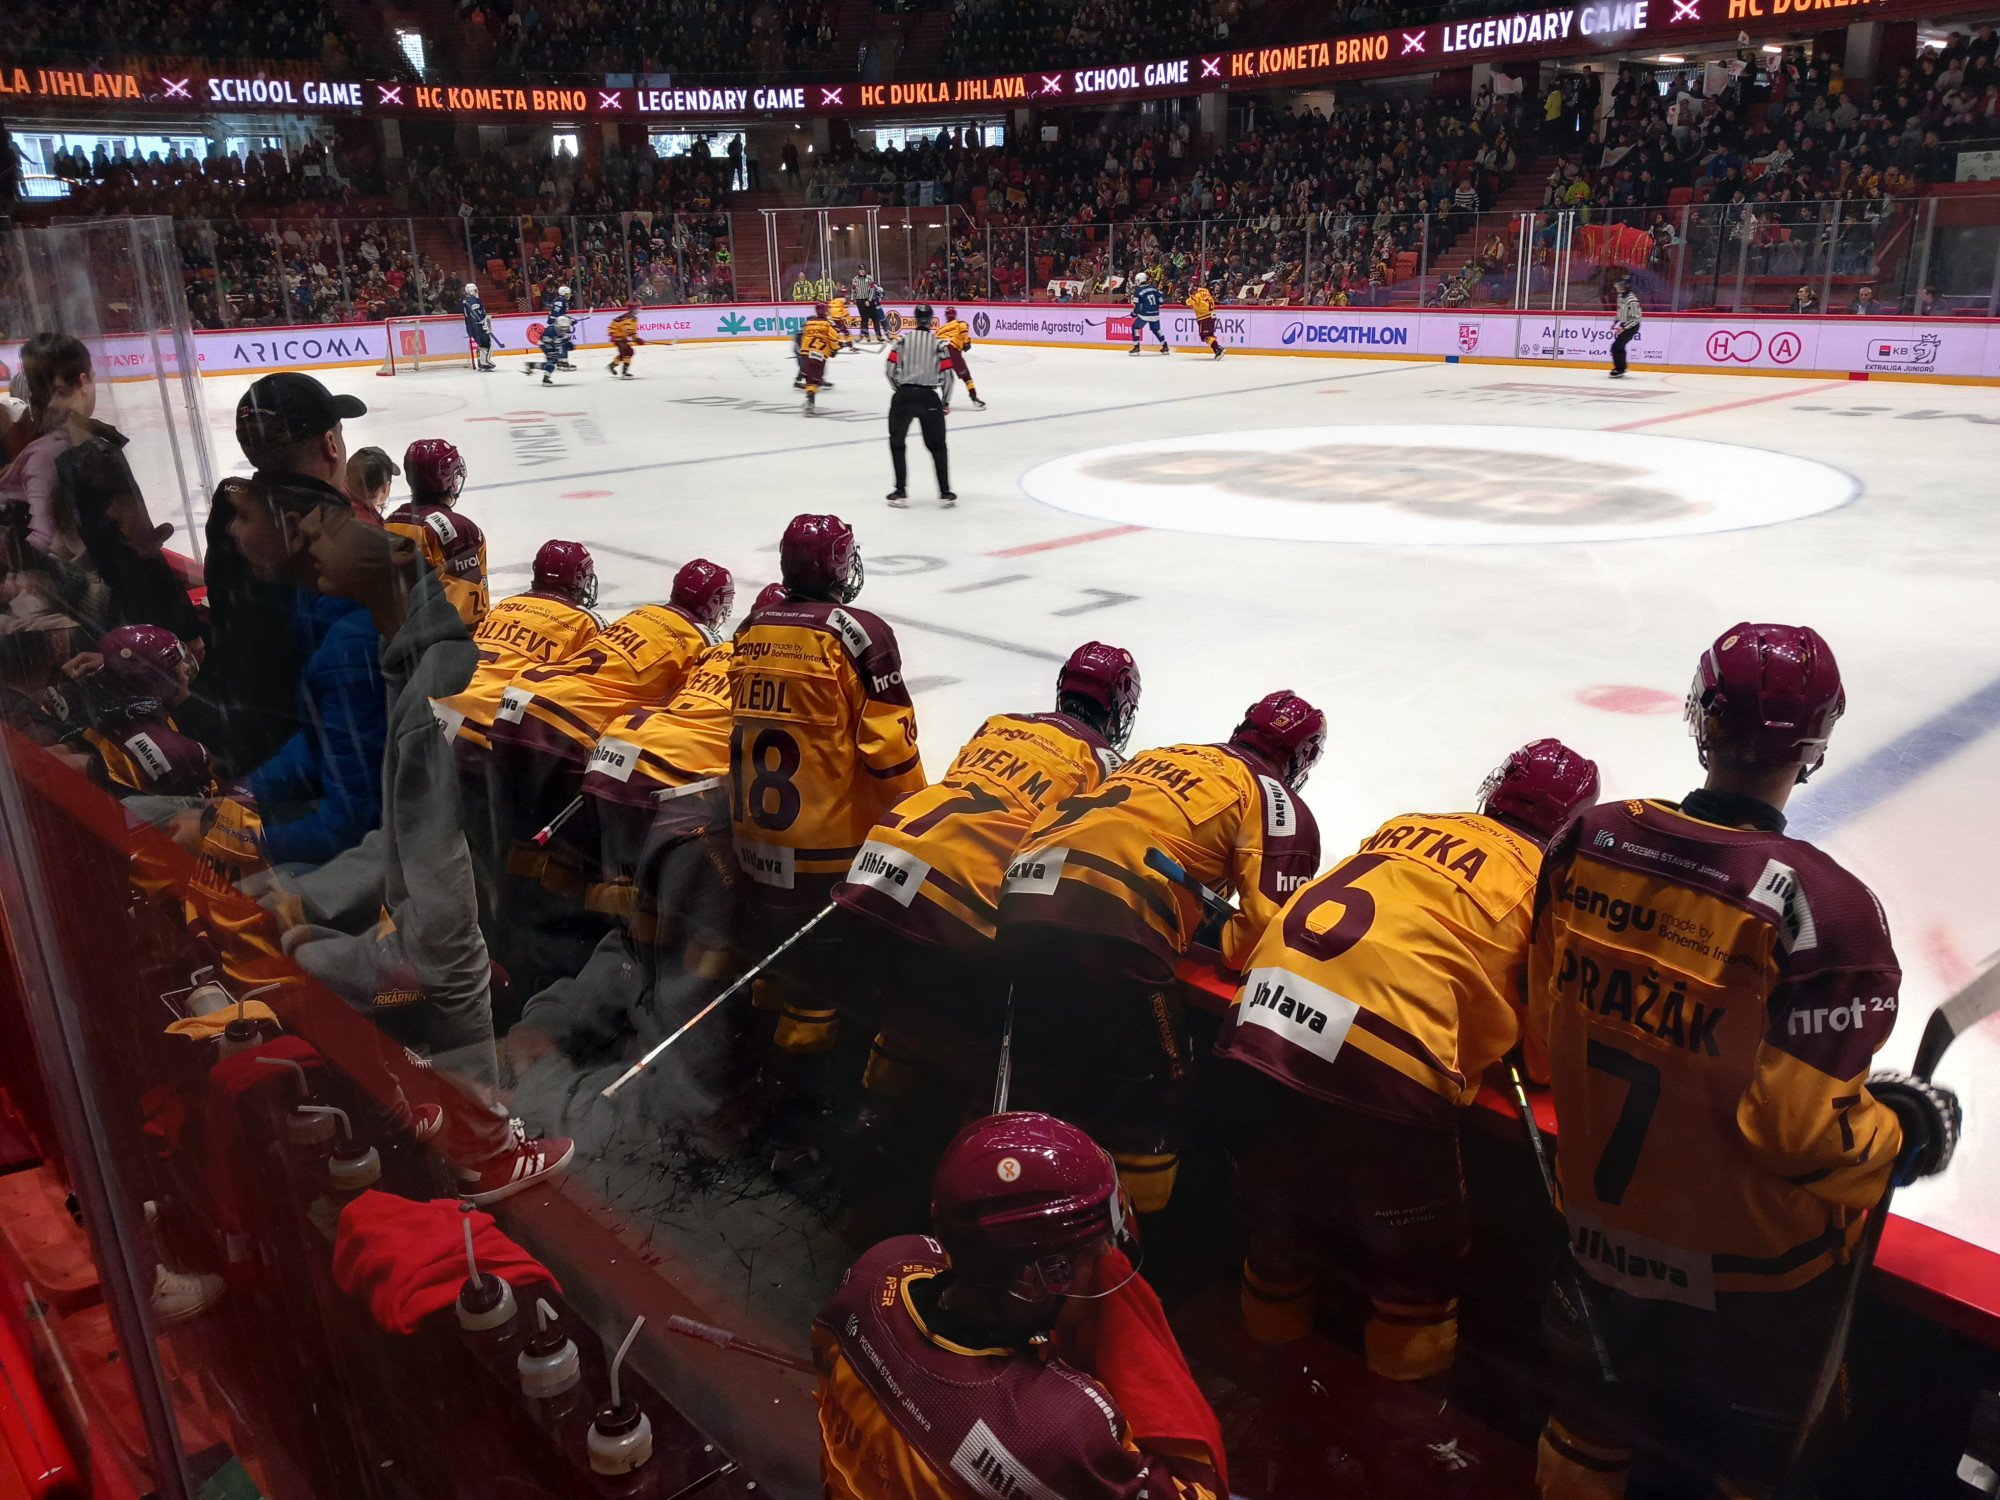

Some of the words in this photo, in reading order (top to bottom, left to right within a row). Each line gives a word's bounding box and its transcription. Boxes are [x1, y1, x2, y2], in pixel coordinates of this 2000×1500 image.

[1443, 11, 1573, 52] LEGENDARY
[1580, 1, 1648, 35] GAME
[1232, 52, 1253, 76] HC
[1259, 43, 1330, 73] KOMETA
[1335, 35, 1389, 65] BRNO
[38, 70, 142, 98] JIHLAVA
[1075, 66, 1139, 93] SCHOOL
[1144, 60, 1189, 86] GAME
[208, 79, 297, 103] SCHOOL
[303, 82, 363, 105] GAME
[416, 86, 443, 108] HC
[448, 88, 527, 110] KOMETA
[532, 90, 587, 111] BRNO
[638, 90, 747, 111] LEGENDARY
[753, 88, 805, 109] GAME
[861, 85, 885, 105] HC
[890, 82, 950, 105] DUKLA
[954, 77, 1026, 101] JIHLAVA
[636, 322, 672, 332] SKUPINA
[673, 321, 691, 330] ČEZ
[995, 319, 1039, 332] Akademie
[1041, 319, 1084, 336] Agrostroj
[1111, 322, 1134, 335] Jihlav
[1306, 325, 1407, 345] DECATHLON
[1542, 326, 1578, 339] Auto
[233, 337, 370, 363] ARICOMA
[1893, 347, 1909, 356] KB
[1864, 363, 1902, 372] EXTRALIGA
[430, 514, 450, 537] Jihlava
[601, 622, 648, 660] ÁTAL
[771, 649, 802, 659] Bohemia
[772, 643, 793, 651] made
[794, 643, 803, 652] by
[872, 671, 902, 694] hro
[135, 738, 161, 771] Jihlava
[590, 745, 626, 768] hlava
[730, 724, 801, 832] 18
[1018, 771, 1053, 812] M.
[1268, 782, 1286, 827] Jihlava
[858, 851, 909, 887] Jihlava
[1276, 871, 1308, 892] hro
[1283, 853, 1400, 962] 6
[1659, 925, 1711, 956] Bohemia
[1661, 912, 1697, 934] made
[1699, 927, 1715, 941] by
[1557, 948, 1727, 1057] PRAŽÁK
[1870, 997, 1897, 1012] 24
[1586, 1037, 1661, 1206] 7
[1832, 1093, 1861, 1152] 7
[1574, 1225, 1690, 1289] Jihlava
[881, 1275, 898, 1308] APER
